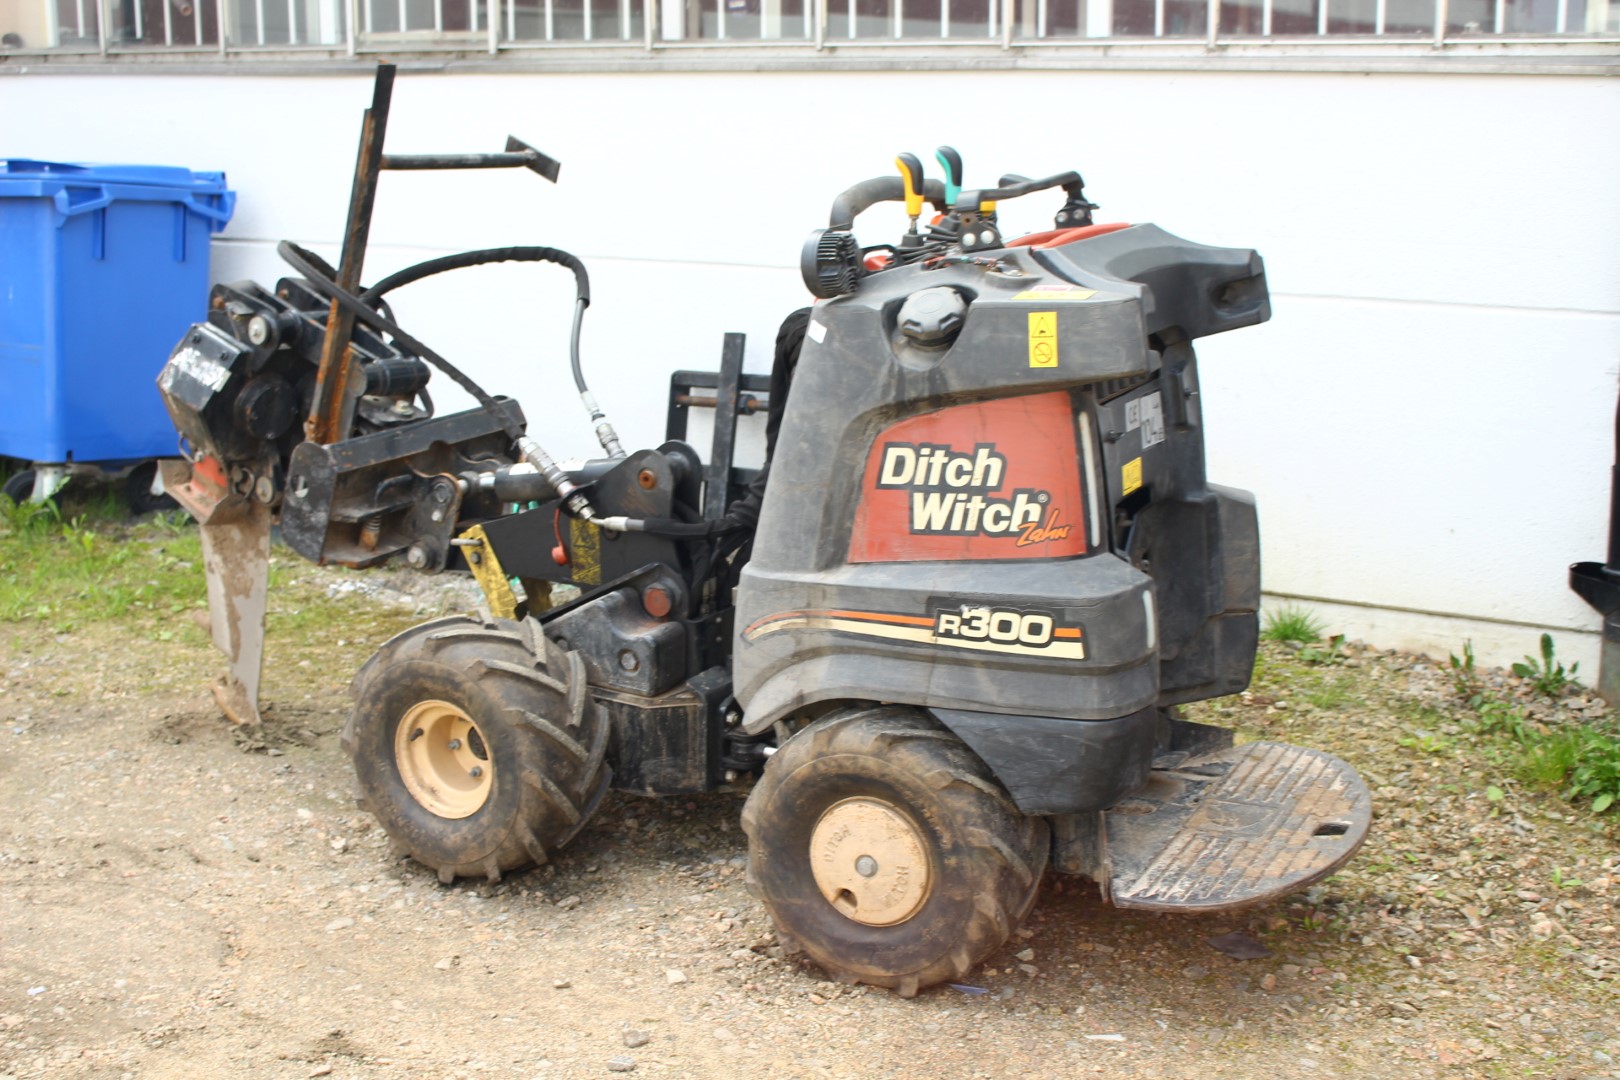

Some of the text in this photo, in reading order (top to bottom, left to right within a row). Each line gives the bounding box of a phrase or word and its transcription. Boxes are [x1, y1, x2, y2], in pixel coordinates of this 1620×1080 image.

[880, 446, 1003, 488] Ditch
[912, 491, 1042, 533] Witch
[937, 609, 1053, 645] R300
